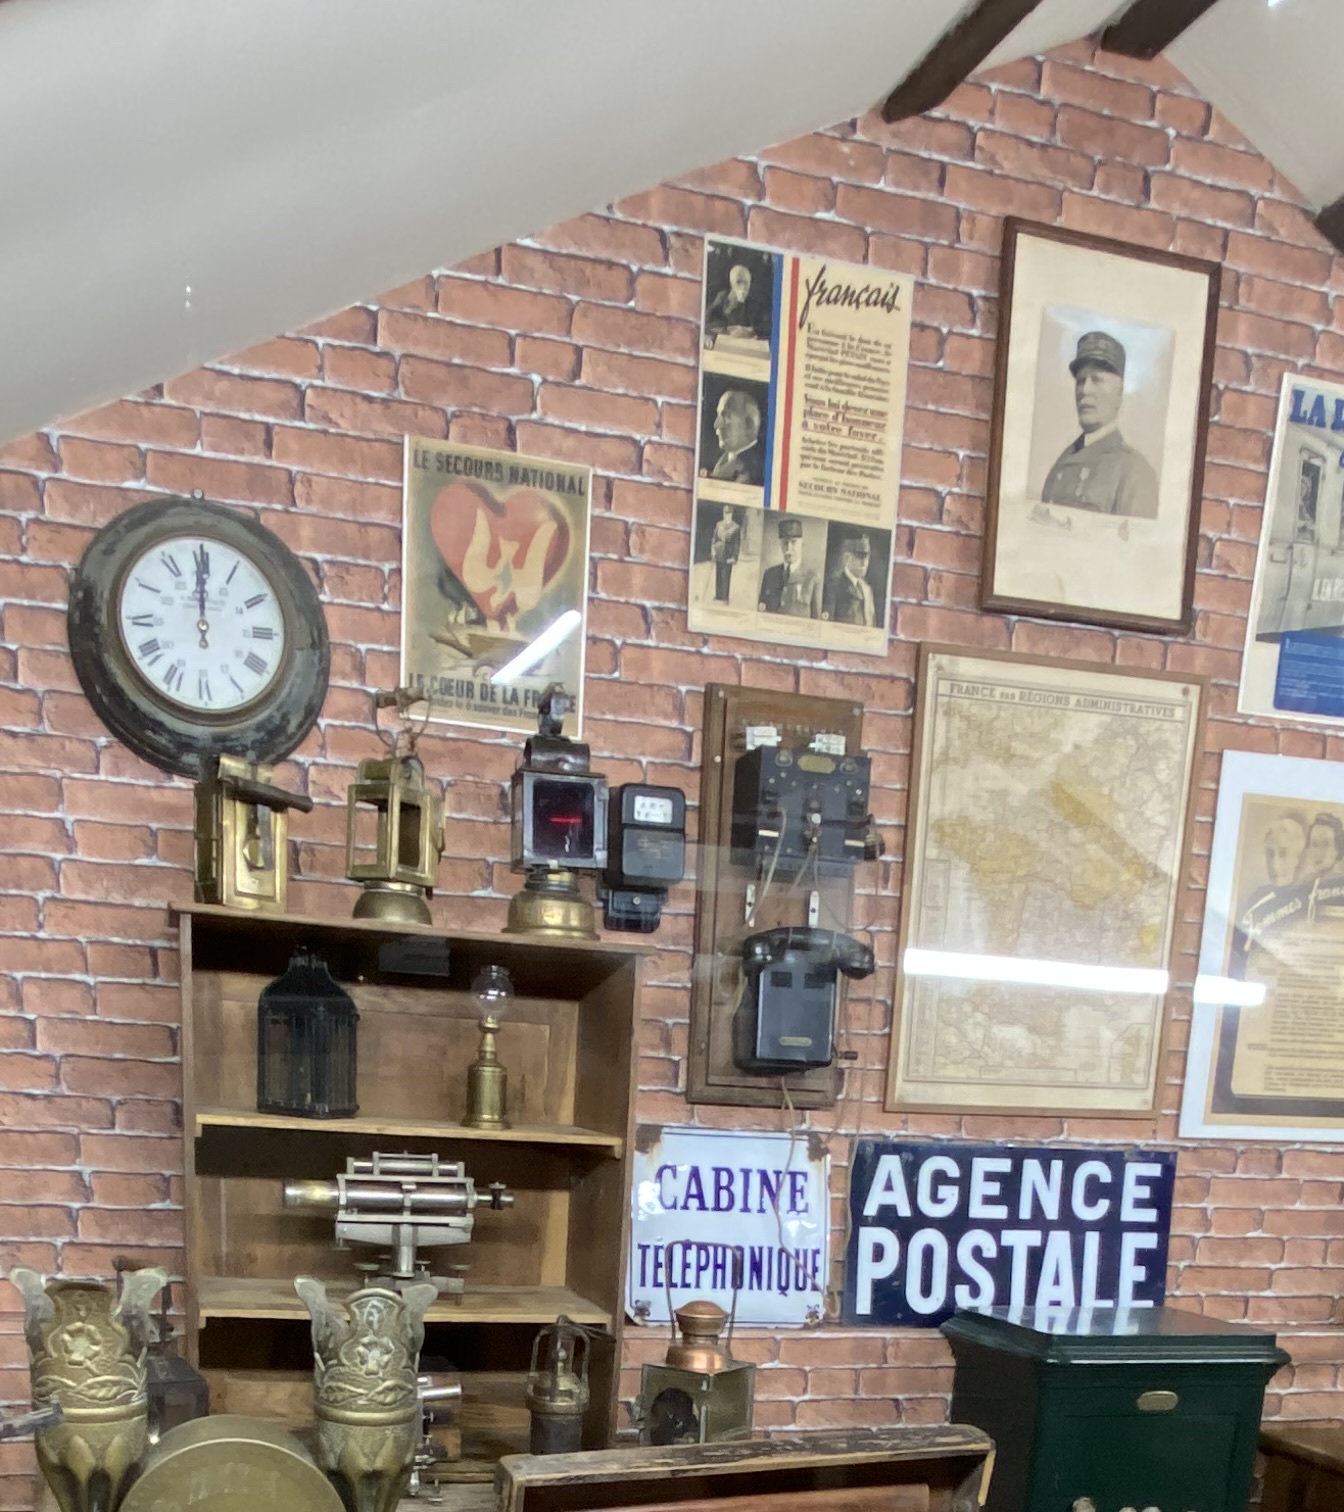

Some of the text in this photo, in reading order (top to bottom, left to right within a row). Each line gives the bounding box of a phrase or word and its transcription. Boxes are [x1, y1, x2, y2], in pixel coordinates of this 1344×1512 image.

[1289, 388, 1327, 428] LA
[509, 466, 585, 496] NATIONAL
[655, 1164, 809, 1214] CABINE
[862, 1154, 1163, 1224] AGENCE
[855, 1226, 1158, 1316] POSTALE
